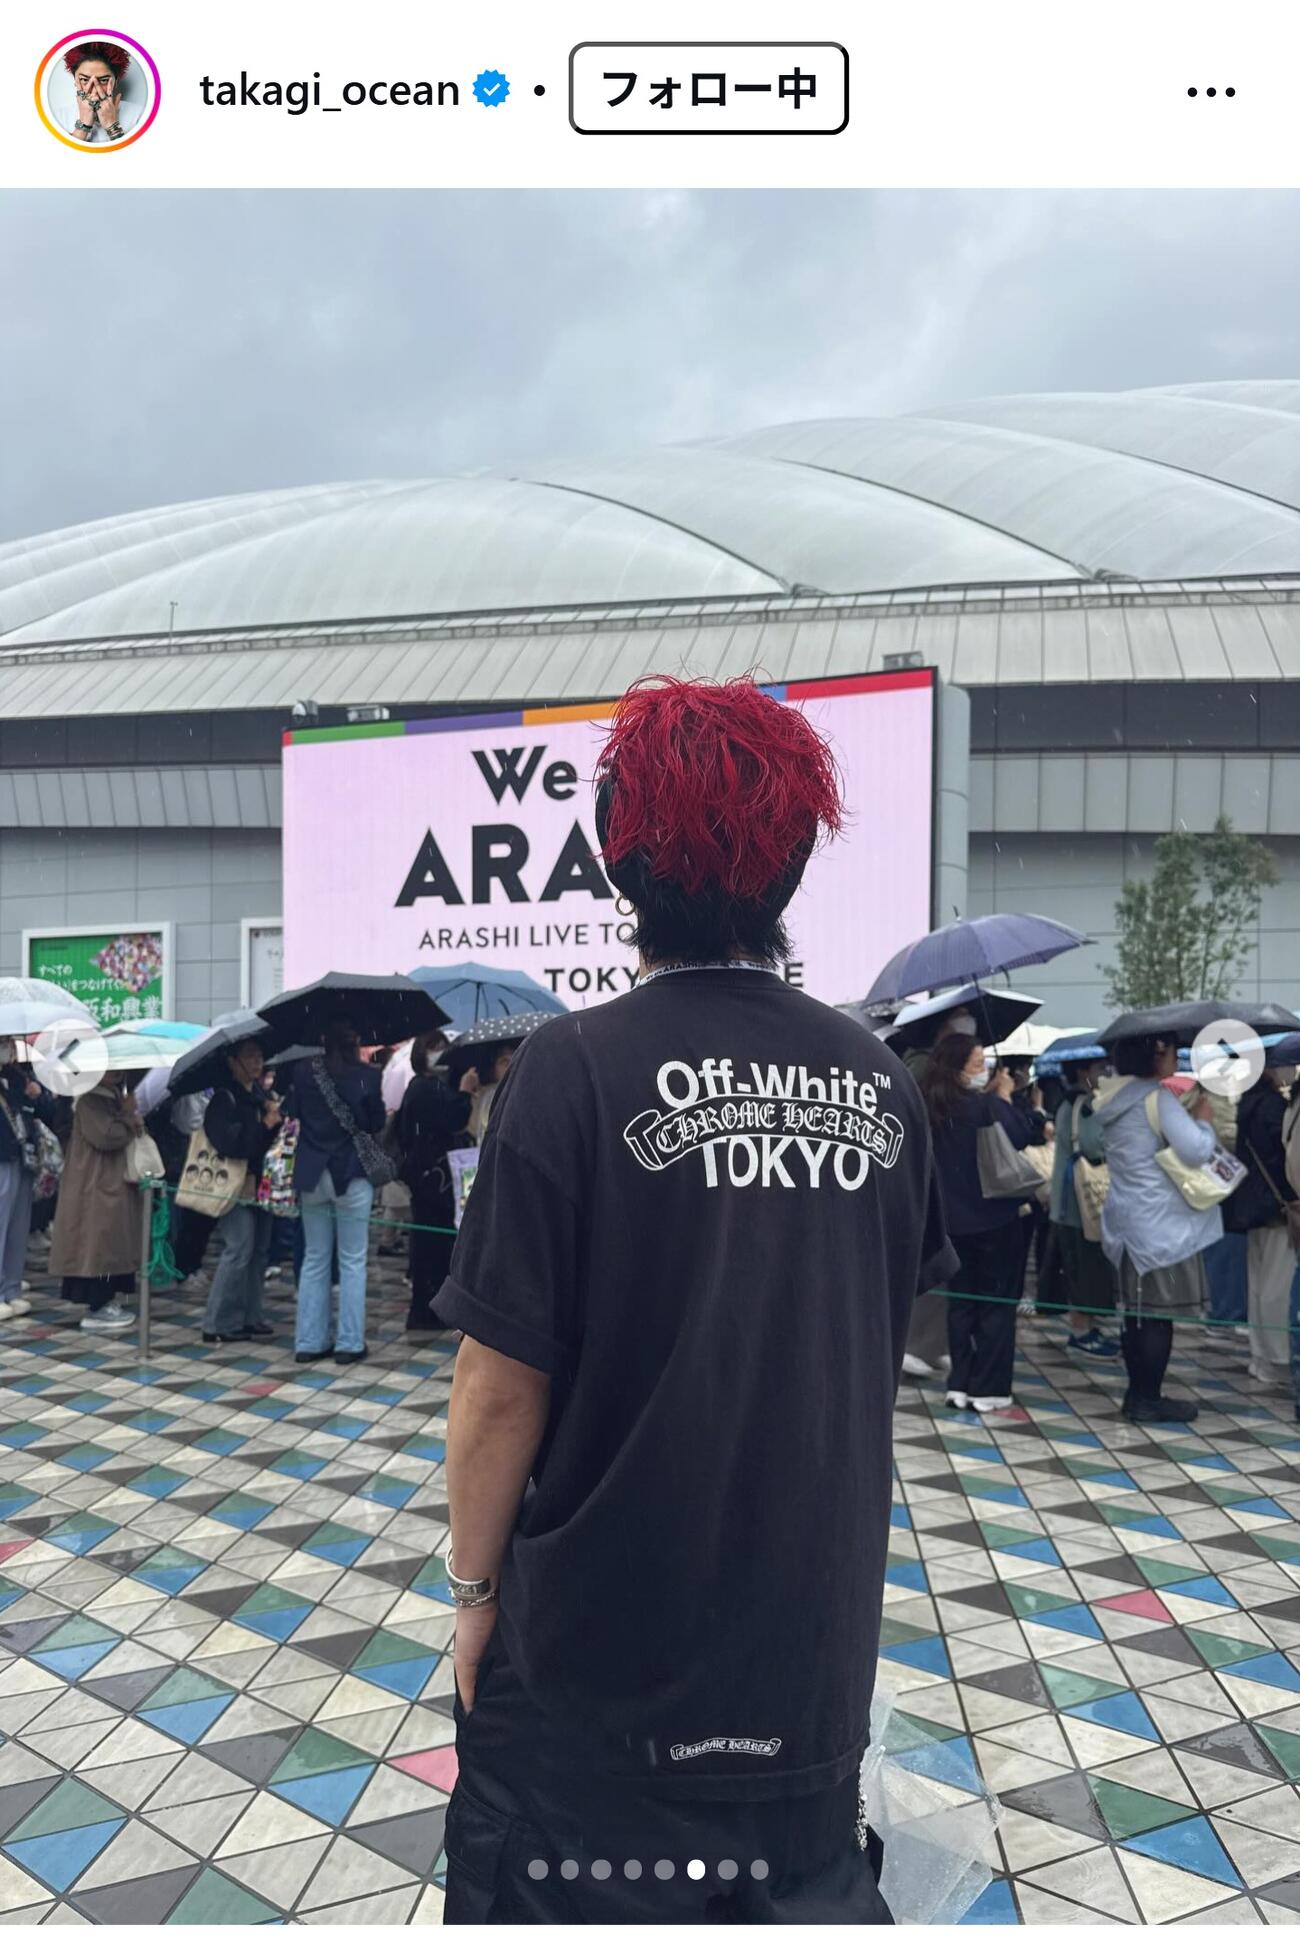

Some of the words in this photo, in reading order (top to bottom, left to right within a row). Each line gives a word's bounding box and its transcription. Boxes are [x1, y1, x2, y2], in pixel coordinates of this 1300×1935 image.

[471, 745, 578, 806] We
[394, 819, 615, 907] ARA
[419, 925, 519, 950] ARASHI
[530, 923, 589, 947] LIVE
[598, 922, 637, 945] TO
[544, 966, 640, 993] TOKY
[656, 1101, 777, 1153] CHROME
[782, 1101, 887, 1156] HEARTS
[703, 1135, 870, 1191] TOKYO
